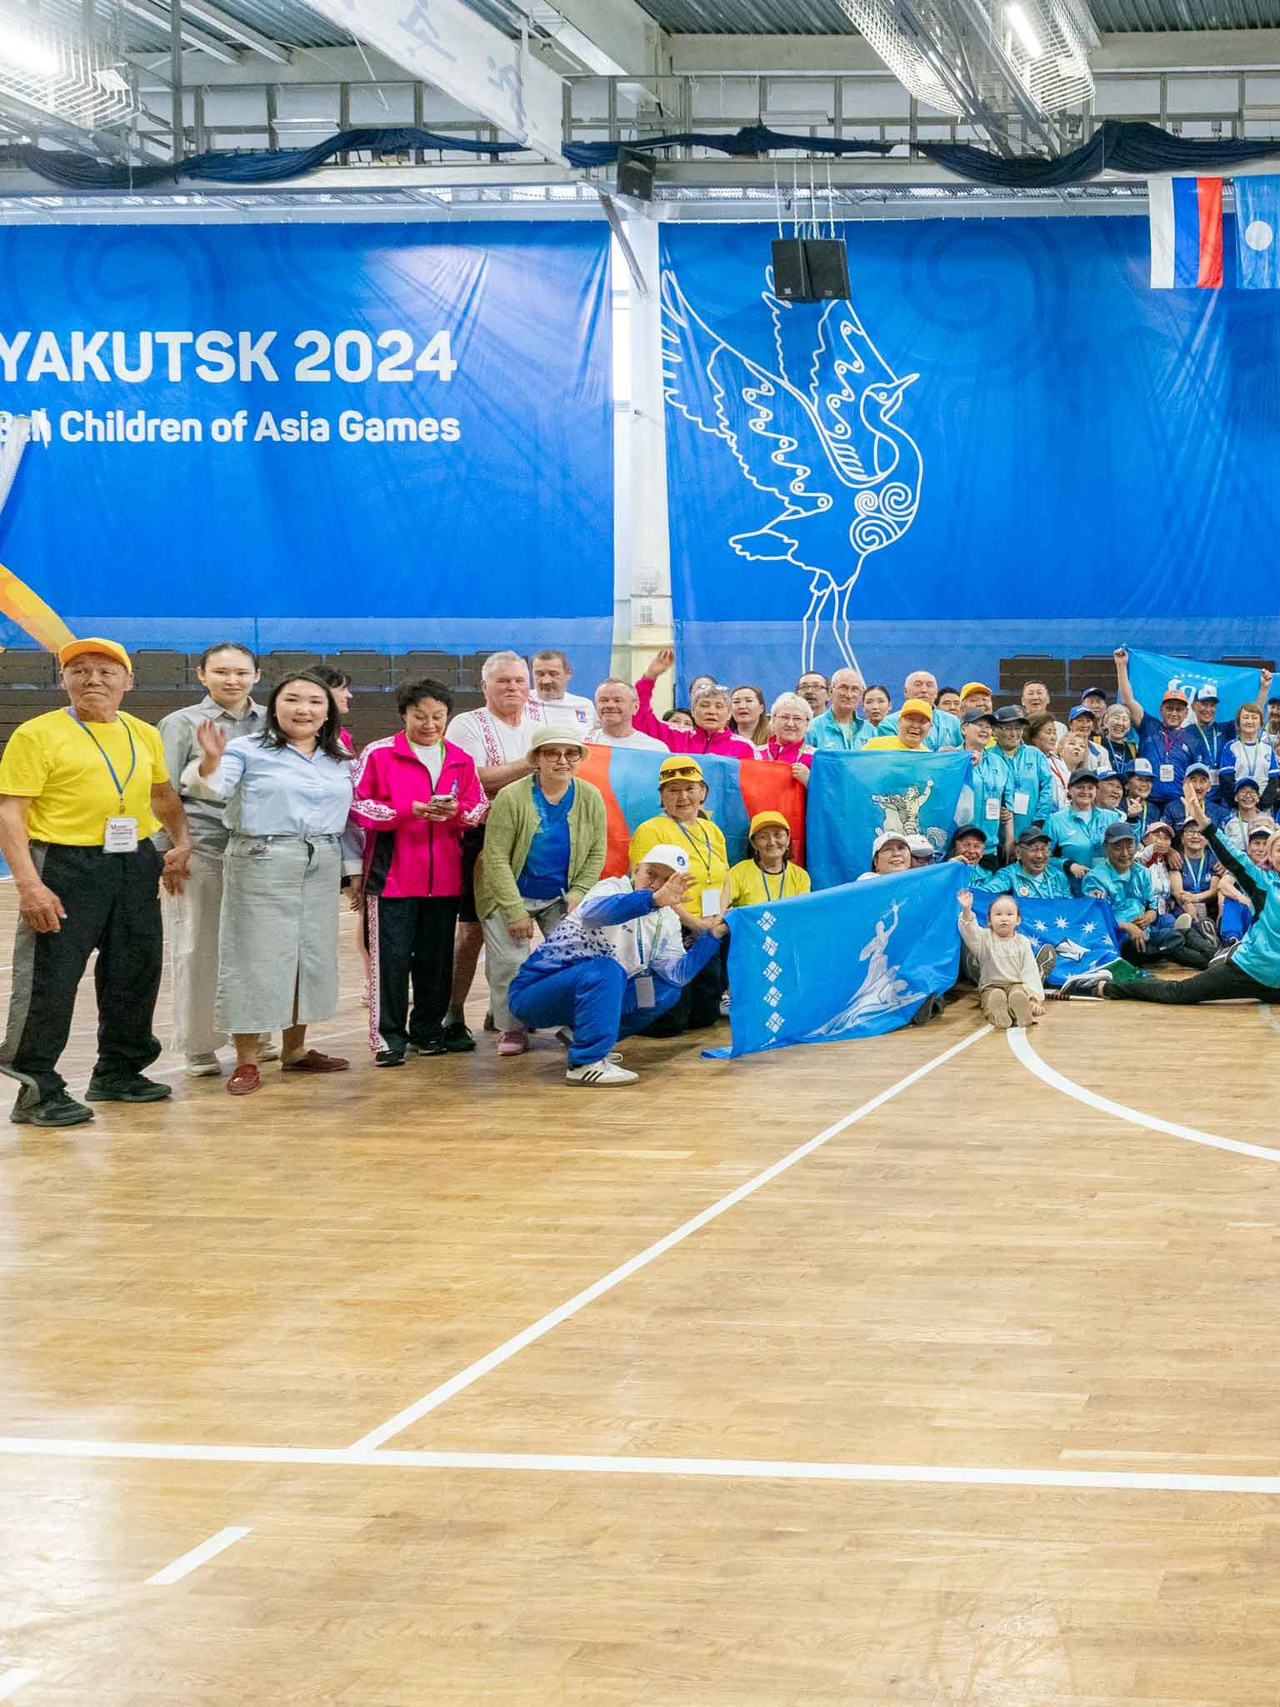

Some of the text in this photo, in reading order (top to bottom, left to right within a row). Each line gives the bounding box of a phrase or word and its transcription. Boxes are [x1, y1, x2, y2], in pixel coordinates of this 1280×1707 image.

[0, 330, 458, 383] YAKUTSK 2024
[60, 409, 203, 443] Children
[211, 410, 248, 443] of
[254, 410, 331, 442] Asia
[338, 412, 461, 443] Games
